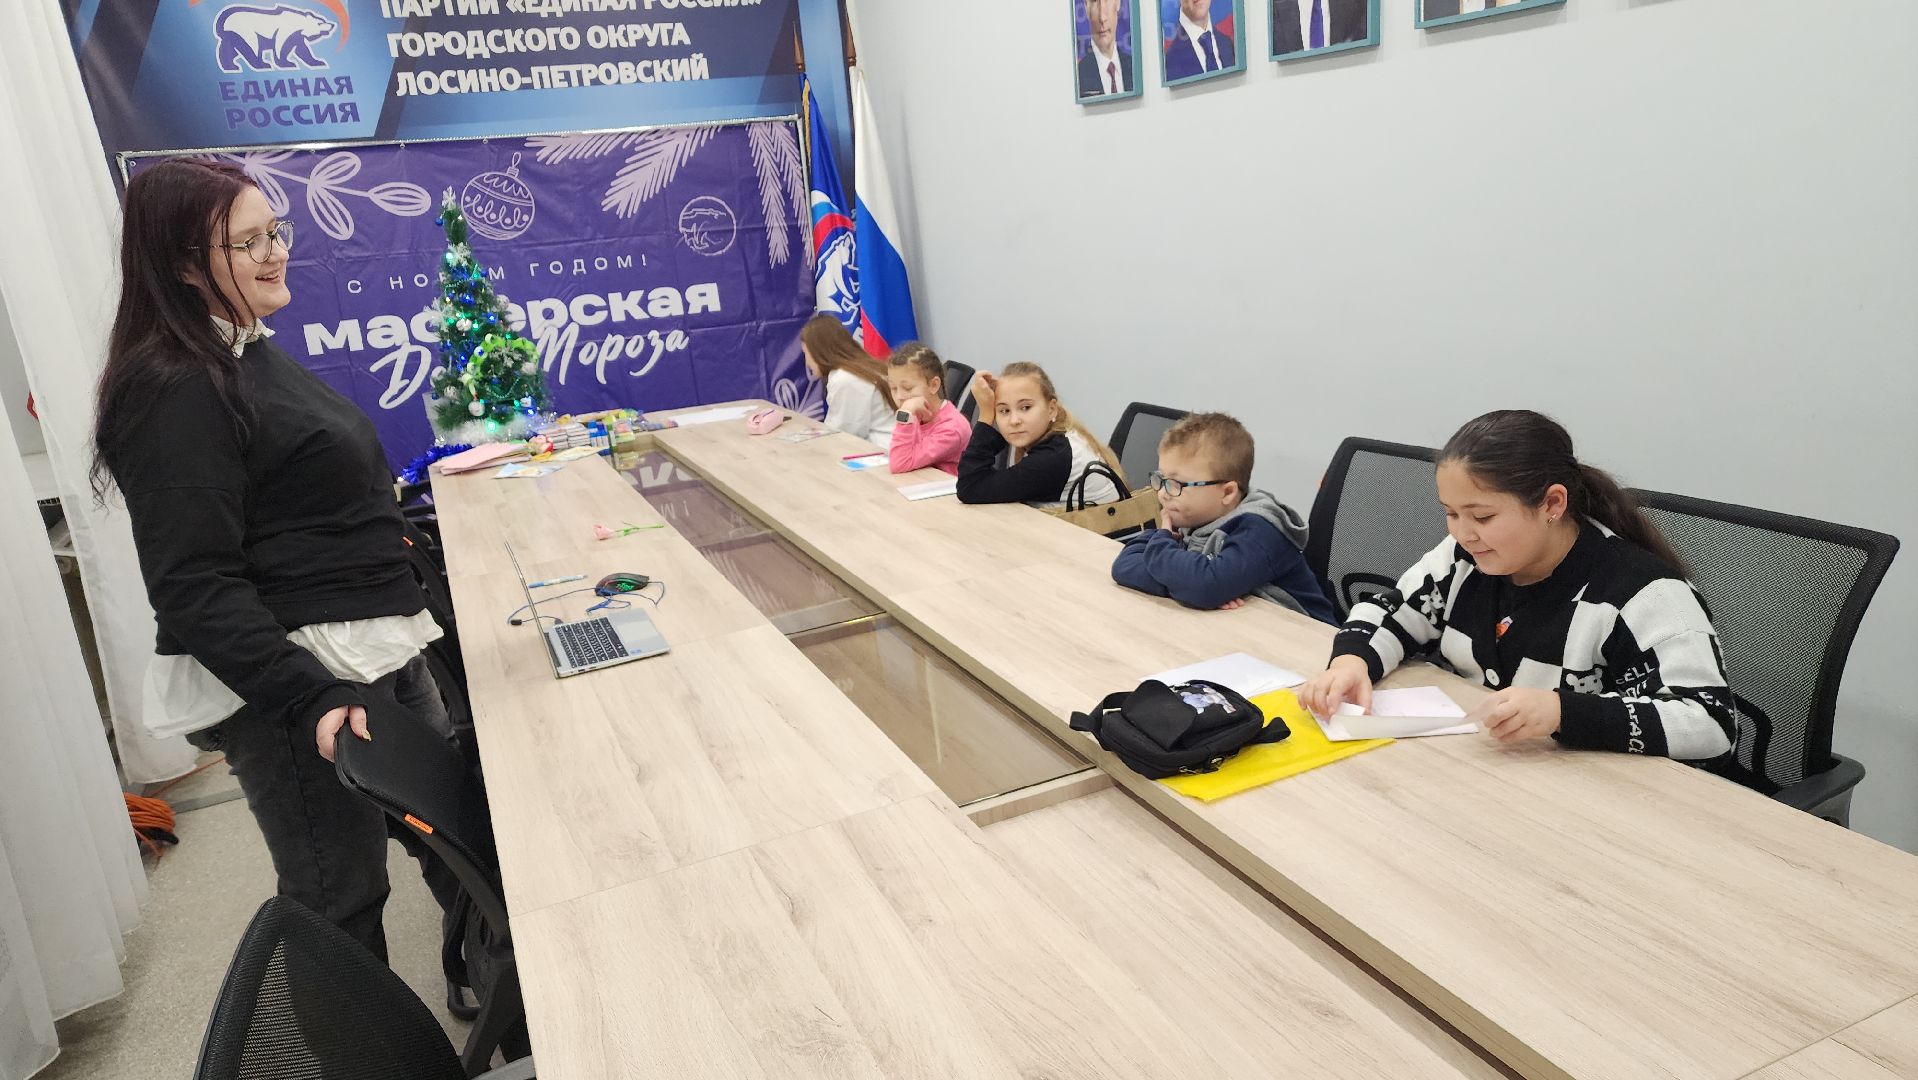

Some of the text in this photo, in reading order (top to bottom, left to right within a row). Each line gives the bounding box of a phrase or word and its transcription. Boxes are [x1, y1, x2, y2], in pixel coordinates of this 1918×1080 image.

[378, 0, 500, 18] ПАРТИИ
[387, 22, 692, 59] ГОРОДСКОГО ОКРУГА
[218, 75, 354, 103] ЕДИНАЯ
[396, 52, 710, 97] ЛОСИНО-ПЕТРОВСКИЙ
[225, 102, 361, 130] РОССИЯ
[347, 253, 648, 294] С НОМ ГОДОМ!
[302, 282, 722, 356] масерская
[536, 321, 690, 386] Мороза
